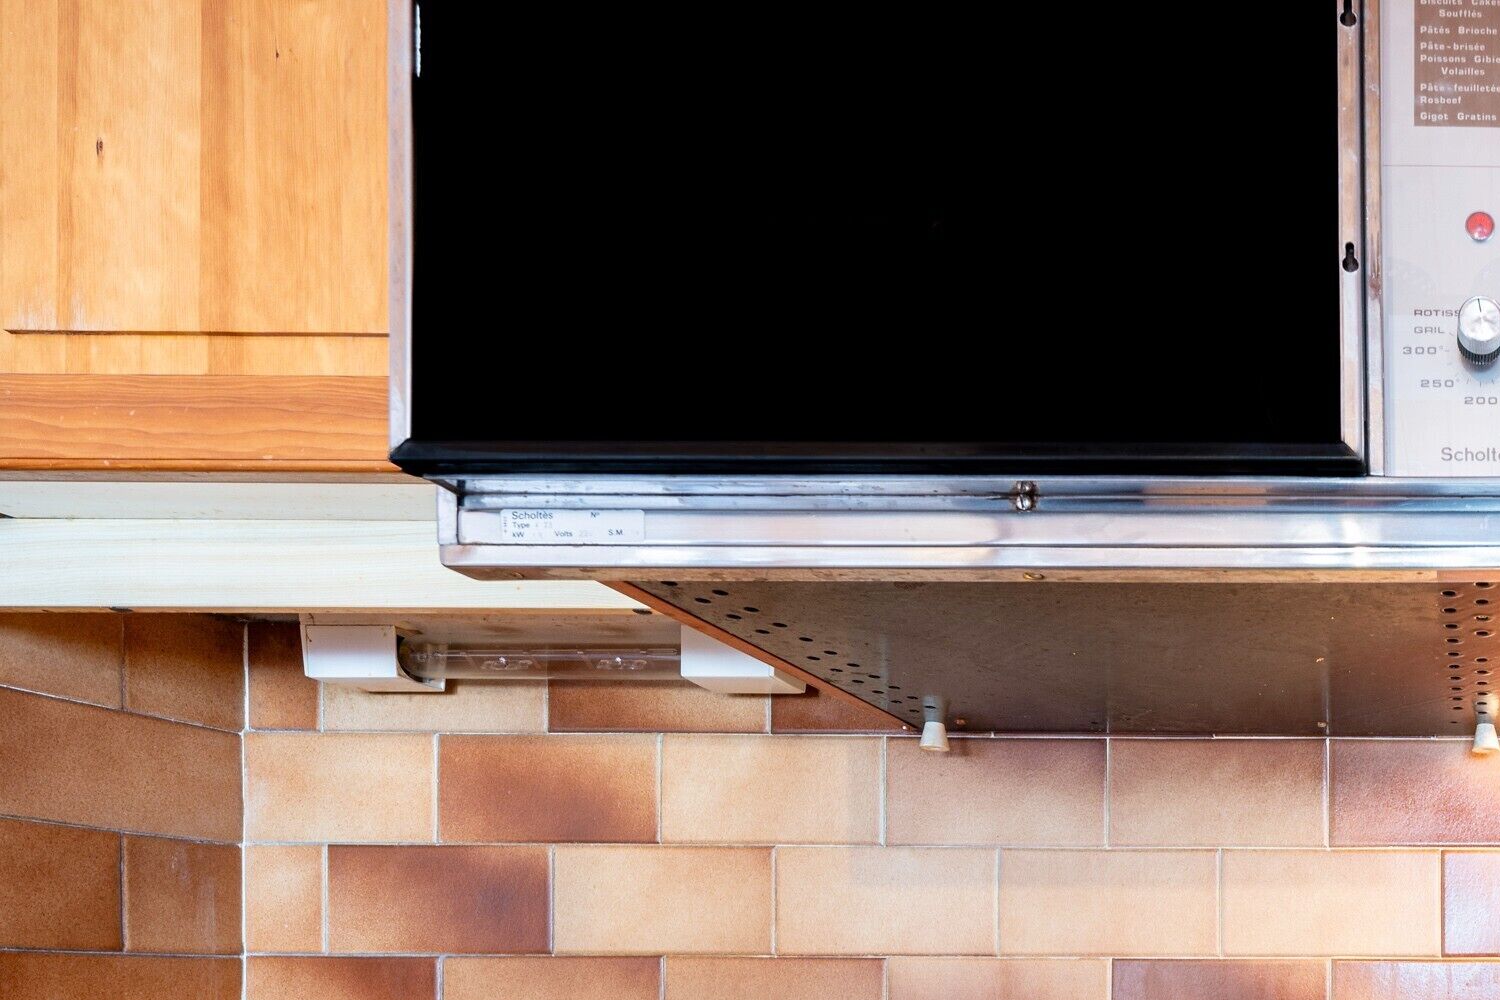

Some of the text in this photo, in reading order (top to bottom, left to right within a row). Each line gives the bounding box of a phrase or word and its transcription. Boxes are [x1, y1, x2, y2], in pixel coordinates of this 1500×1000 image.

[1438, 9, 1482, 18] Soufflés
[1457, 26, 1498, 35] Brioche
[1420, 54, 1466, 63] Poissons
[1441, 66, 1485, 76] Volailles
[1420, 96, 1462, 105] Rosbeef
[1420, 111, 1497, 122] Gigot Gratins
[1413, 326, 1445, 334] GRIL
